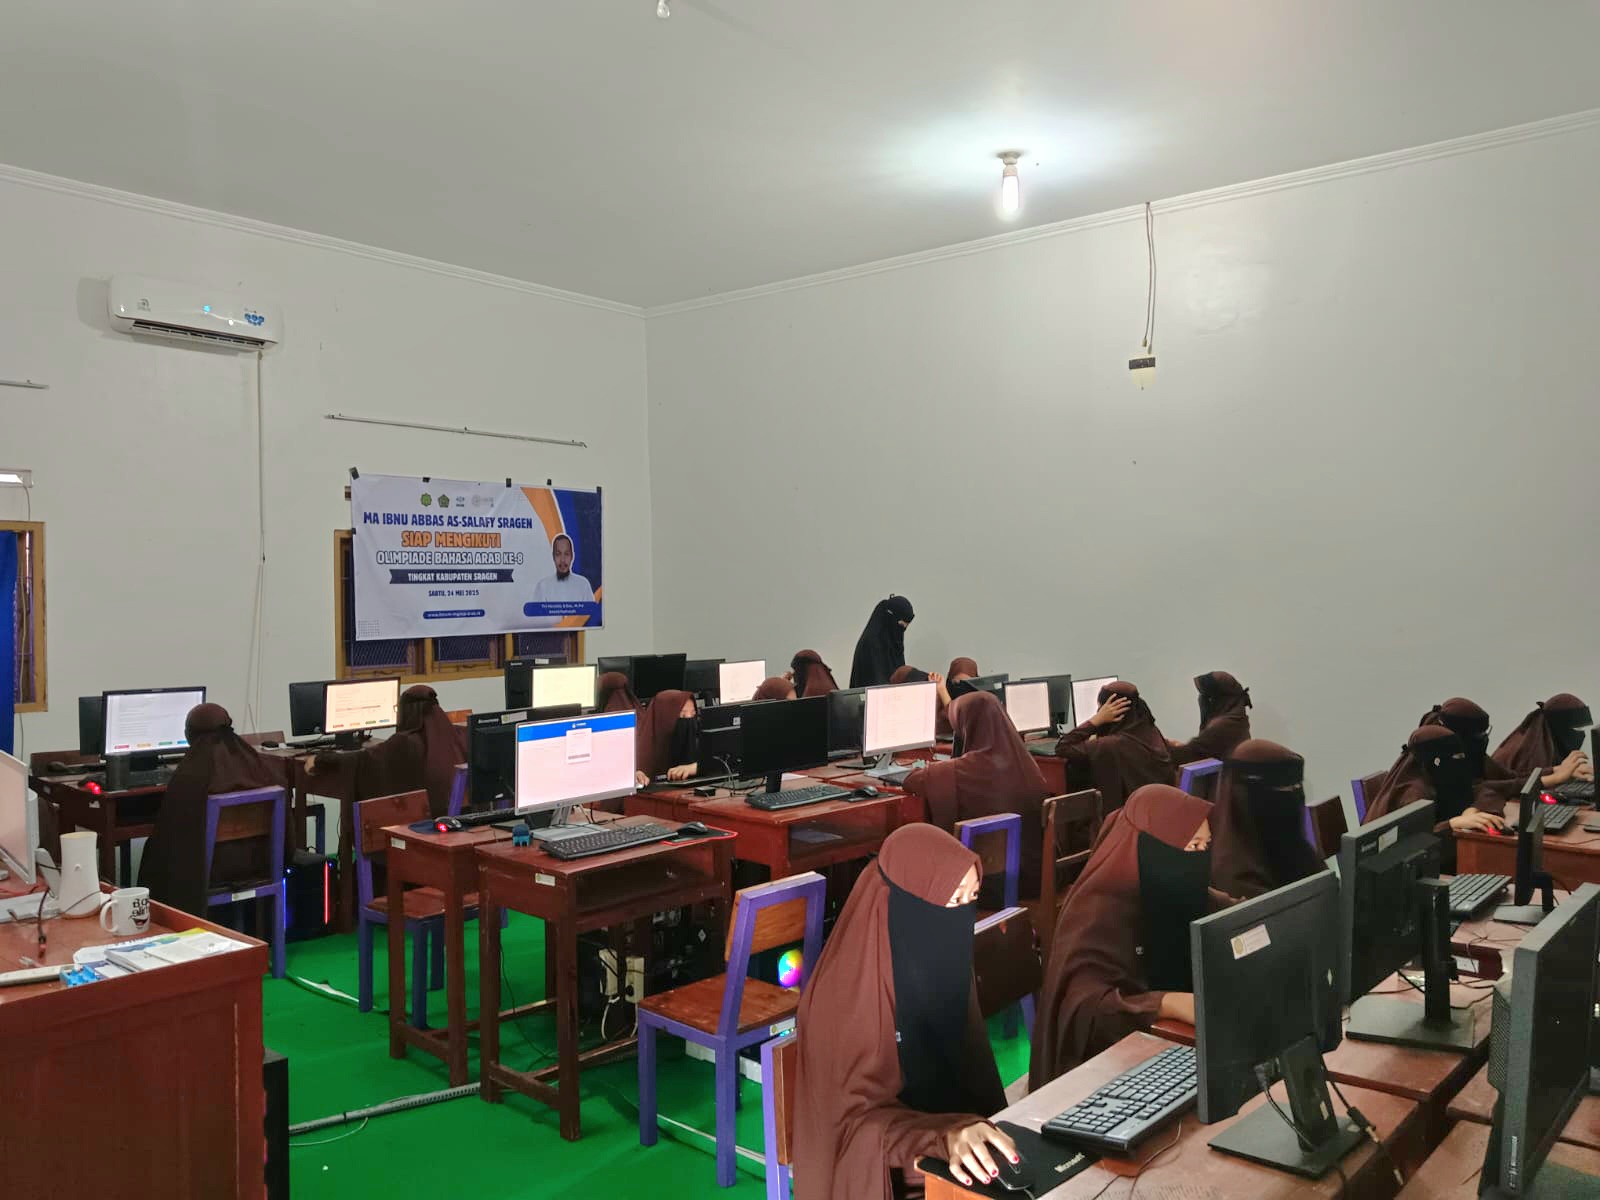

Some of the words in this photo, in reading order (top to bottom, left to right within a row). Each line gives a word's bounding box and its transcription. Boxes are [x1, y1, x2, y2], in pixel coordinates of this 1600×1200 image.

[363, 512, 379, 524] MA
[382, 513, 408, 525] IBNU
[411, 514, 444, 526] ABBAS
[447, 516, 495, 528] AS-SALAFY
[498, 518, 532, 528] SRAGEN
[401, 530, 432, 547] SIAP
[434, 531, 501, 548] MENGIKUTI
[376, 551, 432, 565] OLIMPIADE
[434, 551, 473, 565] BAHASA
[475, 552, 501, 565] ARAB
[503, 551, 523, 565] KE-8
[408, 573, 434, 582] TINGKAT
[436, 573, 472, 581] KABUPATEN
[473, 572, 497, 581] SRAGEN
